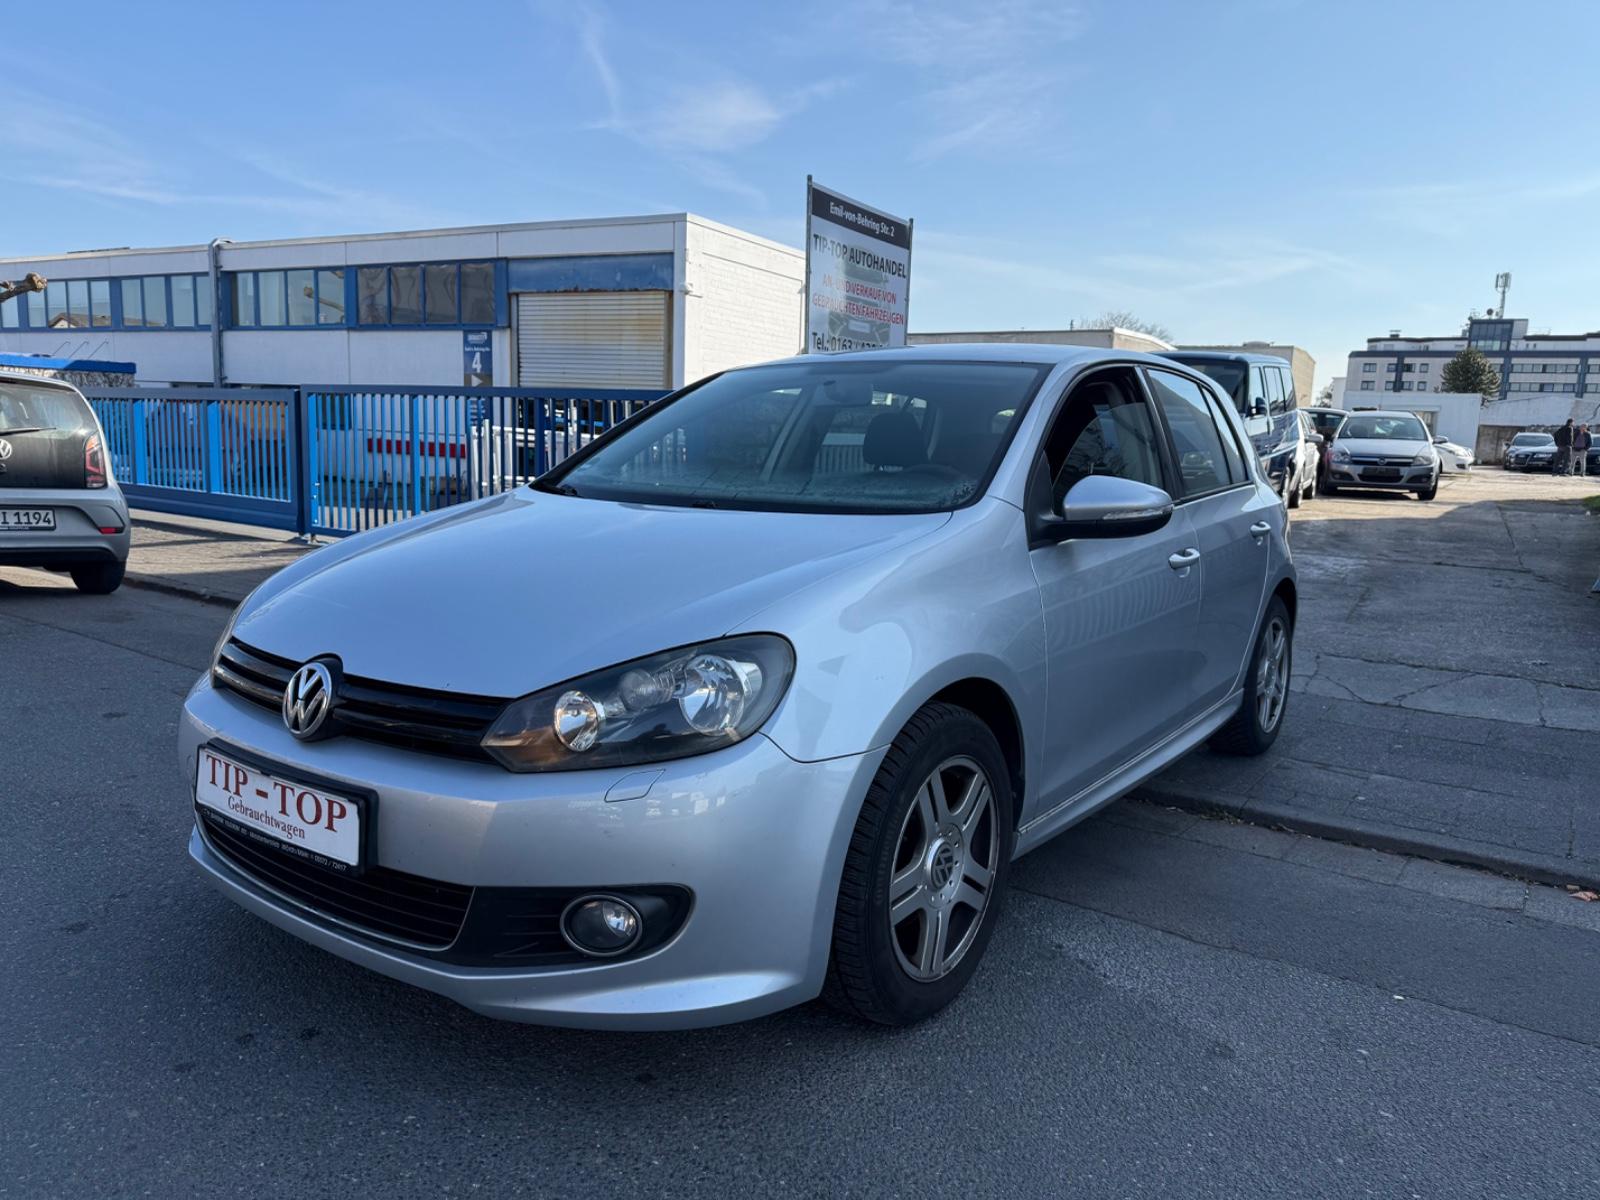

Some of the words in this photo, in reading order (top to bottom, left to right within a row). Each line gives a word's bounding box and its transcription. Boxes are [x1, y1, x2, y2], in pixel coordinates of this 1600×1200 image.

[829, 202, 880, 234] Emil-von-Behring
[890, 226, 895, 237] 2
[813, 234, 848, 260] TIP-TOP
[849, 247, 907, 279] AUTOHANDEL
[882, 291, 897, 304] VON
[861, 305, 904, 325] FAHRZEUGEN
[471, 351, 482, 373] 4
[14, 511, 51, 525] 1194
[206, 754, 248, 797] TIP
[273, 781, 347, 833] TOP
[227, 795, 305, 840] Gebrauchtwagen
